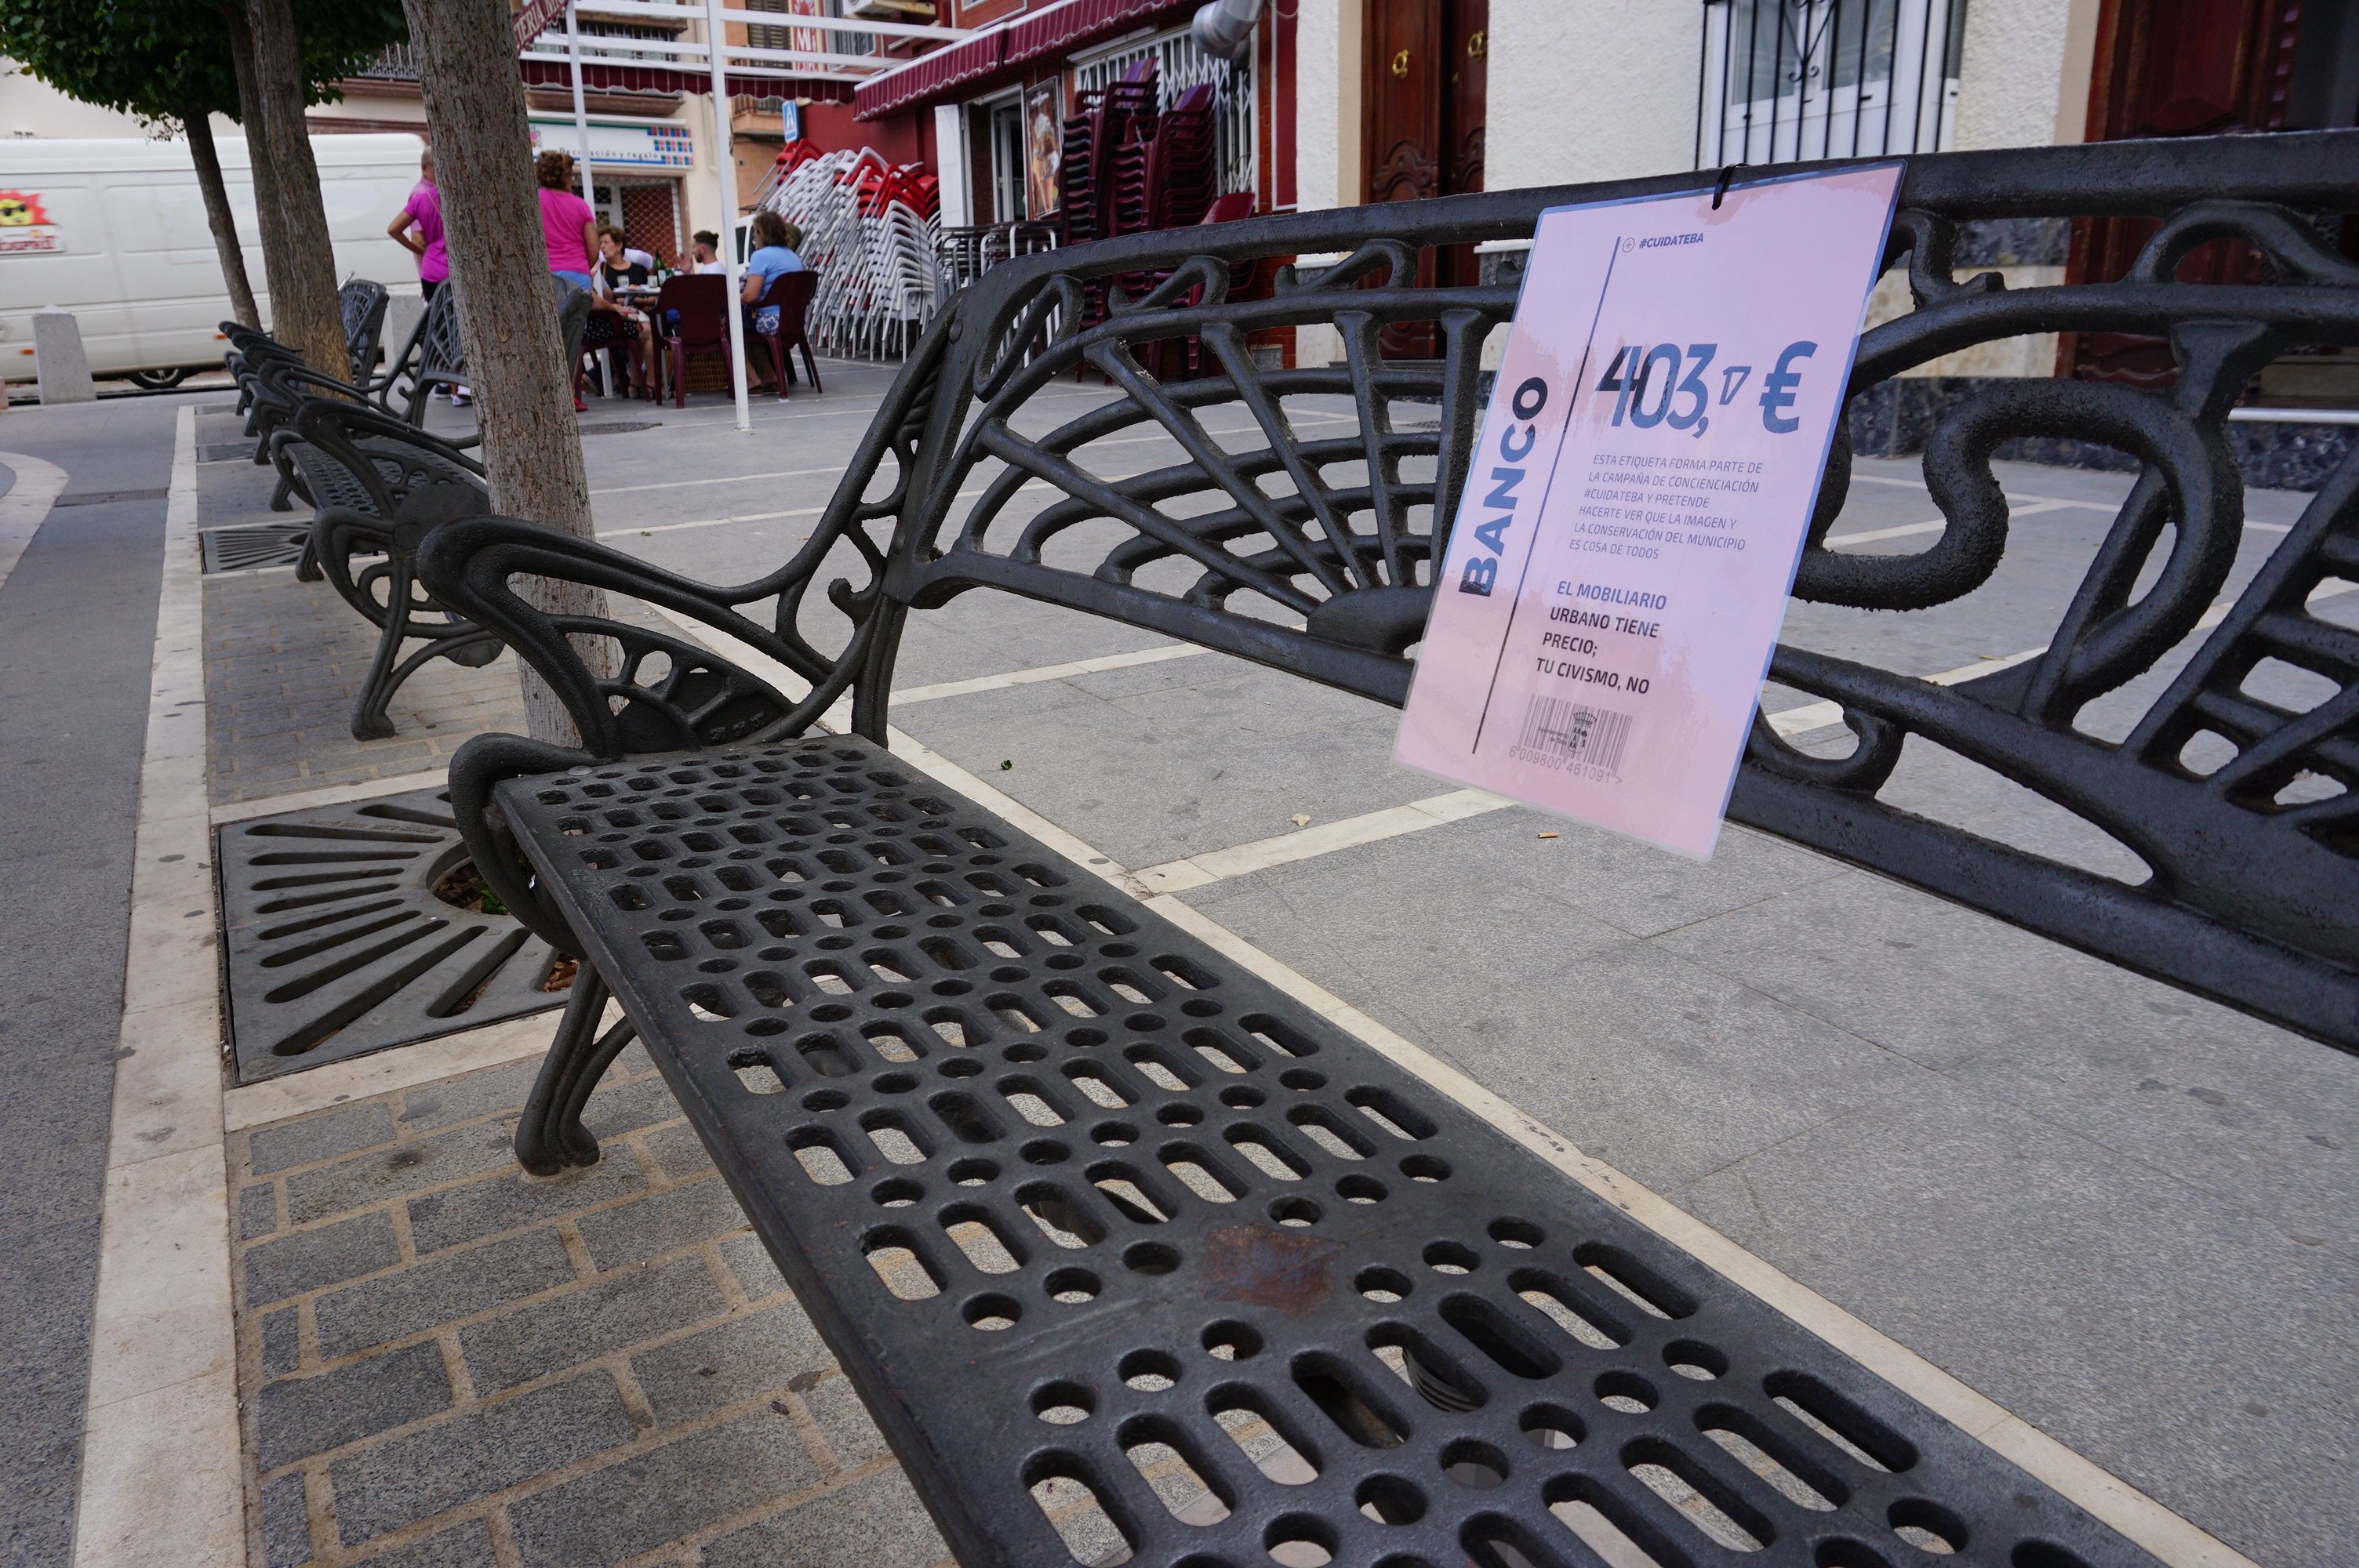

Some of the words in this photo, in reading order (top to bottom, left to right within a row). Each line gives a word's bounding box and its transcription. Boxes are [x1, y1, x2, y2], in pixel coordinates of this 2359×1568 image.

[559, 147, 616, 157] Decación
[1639, 232, 1703, 249] #CUIDATEBA
[1758, 340, 1818, 434] €
[1593, 454, 1616, 465] ESTA
[1619, 456, 1667, 469] ETIQUETA
[1669, 458, 1706, 470] FORMA
[1709, 460, 1745, 473] PARTE
[1747, 462, 1763, 474] DE
[1459, 376, 1548, 597] BANCO
[1588, 471, 1600, 481] LA
[1602, 472, 1649, 485] CAMPAÑA
[1652, 475, 1667, 486] DE
[1668, 476, 1759, 493] CONCIENCIACIÓN
[1583, 488, 1643, 503] #CUIDATEBA
[1647, 494, 1653, 503] Y
[1655, 494, 1710, 509] PRETENDE
[1579, 506, 1622, 519] HACERTE
[1624, 509, 1643, 521] VER
[1645, 511, 1667, 524] QUE
[1668, 513, 1681, 524] LA
[1683, 515, 1728, 529] IMAGEN
[1729, 518, 1737, 530] Y
[1574, 522, 1586, 533] LA
[1587, 523, 1663, 542] CONSERVACIÓN
[1665, 532, 1685, 544] DEL
[1687, 534, 1746, 550] MUNICIPIO
[1569, 539, 1581, 550] ES
[1583, 540, 1608, 553] COSA
[1609, 544, 1624, 555] DE
[1626, 545, 1659, 560] TODOS
[1557, 580, 1572, 596] EL
[1576, 583, 1667, 610] MOBILIARIO
[1550, 606, 1610, 630] URBANO
[1616, 617, 1660, 638] TIENE
[1542, 632, 1598, 658] PRECIO;
[1537, 657, 1554, 673] TU
[1557, 662, 1621, 691] CIVISMO,
[1626, 676, 1650, 694] NO
